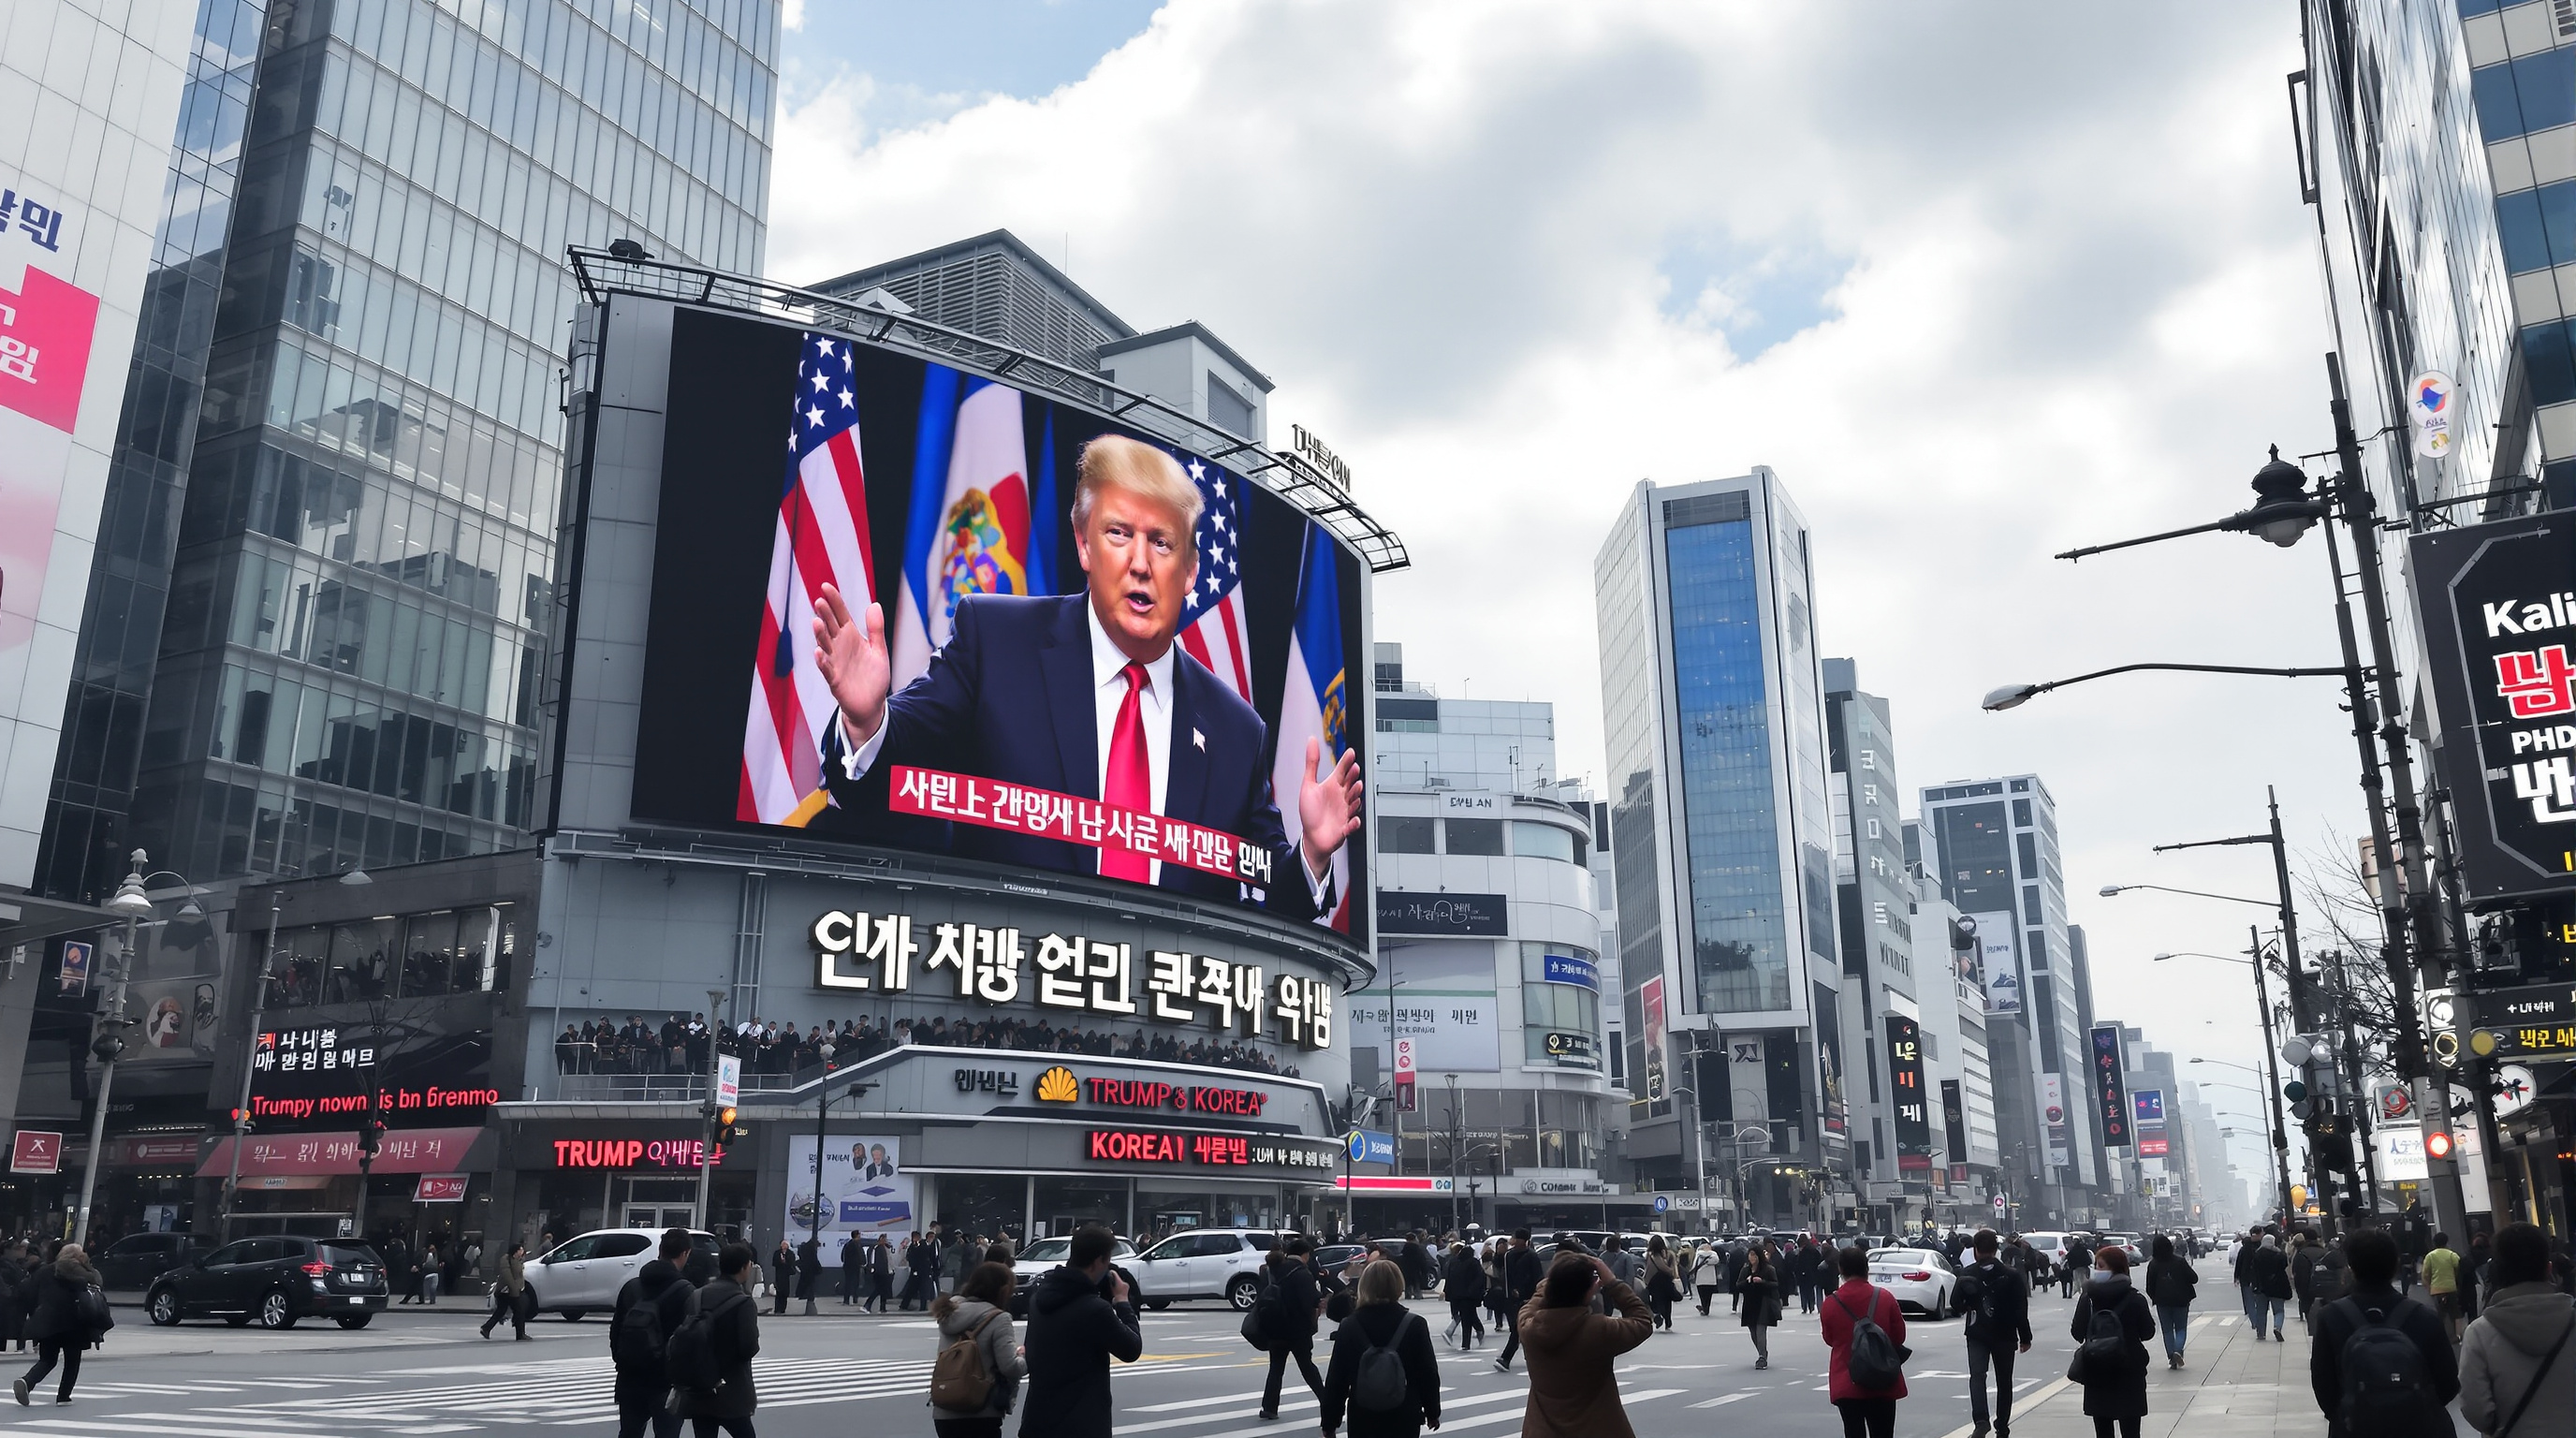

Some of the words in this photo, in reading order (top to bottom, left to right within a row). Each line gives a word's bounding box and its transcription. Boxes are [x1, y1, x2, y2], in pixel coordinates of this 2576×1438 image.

[253, 1096, 315, 1118] Trumpy
[319, 1095, 367, 1112] nown
[379, 1088, 393, 1109] is
[399, 1088, 421, 1108] bn
[1090, 1078, 1171, 1108] TRUMP
[1194, 1086, 1261, 1116] KOREA
[554, 1140, 643, 1167] TRUMP
